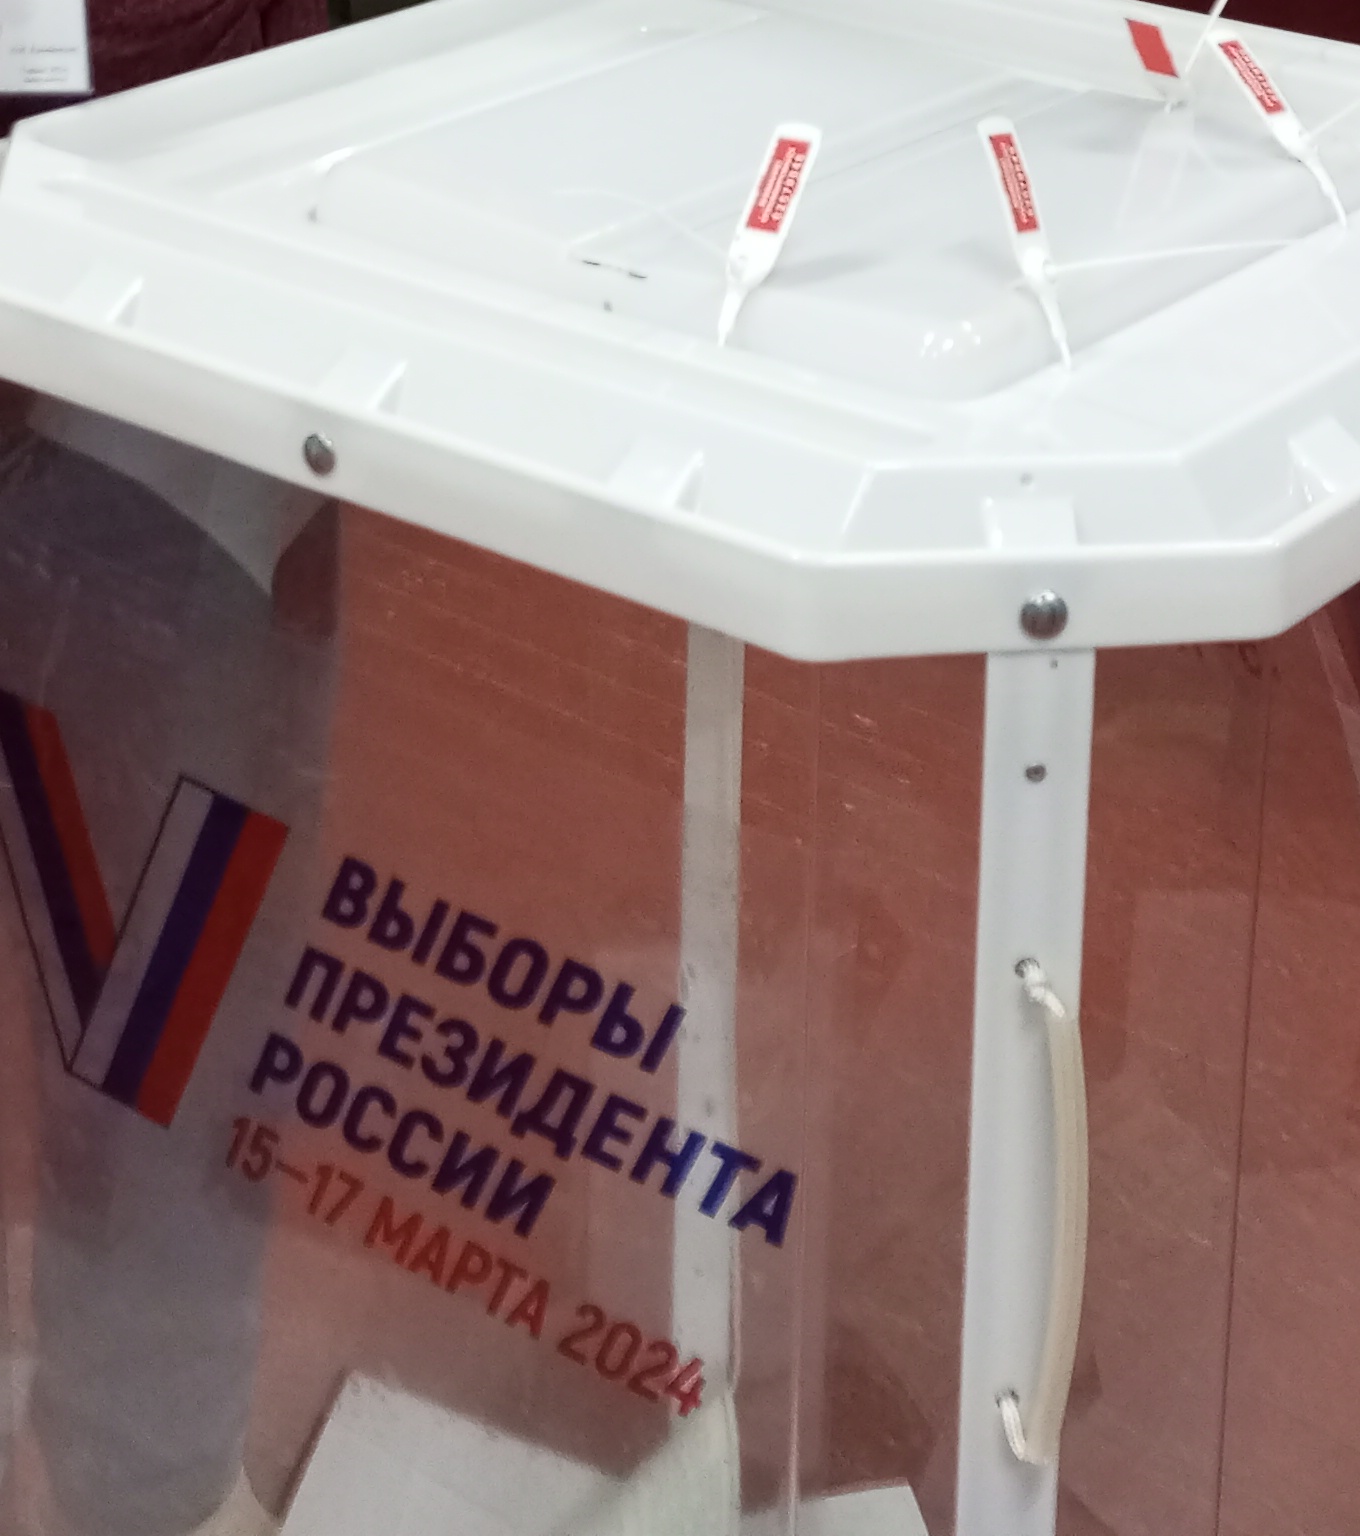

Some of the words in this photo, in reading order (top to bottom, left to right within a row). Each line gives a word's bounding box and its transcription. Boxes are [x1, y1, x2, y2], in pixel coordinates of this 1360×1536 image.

[321, 855, 686, 1076] ВЫБОРЫ
[247, 1030, 558, 1240] РОССИИ
[283, 945, 800, 1248] ПРЕЗИДЕНТА
[362, 1203, 554, 1340] МАРТА
[556, 1304, 706, 1418] 2024
